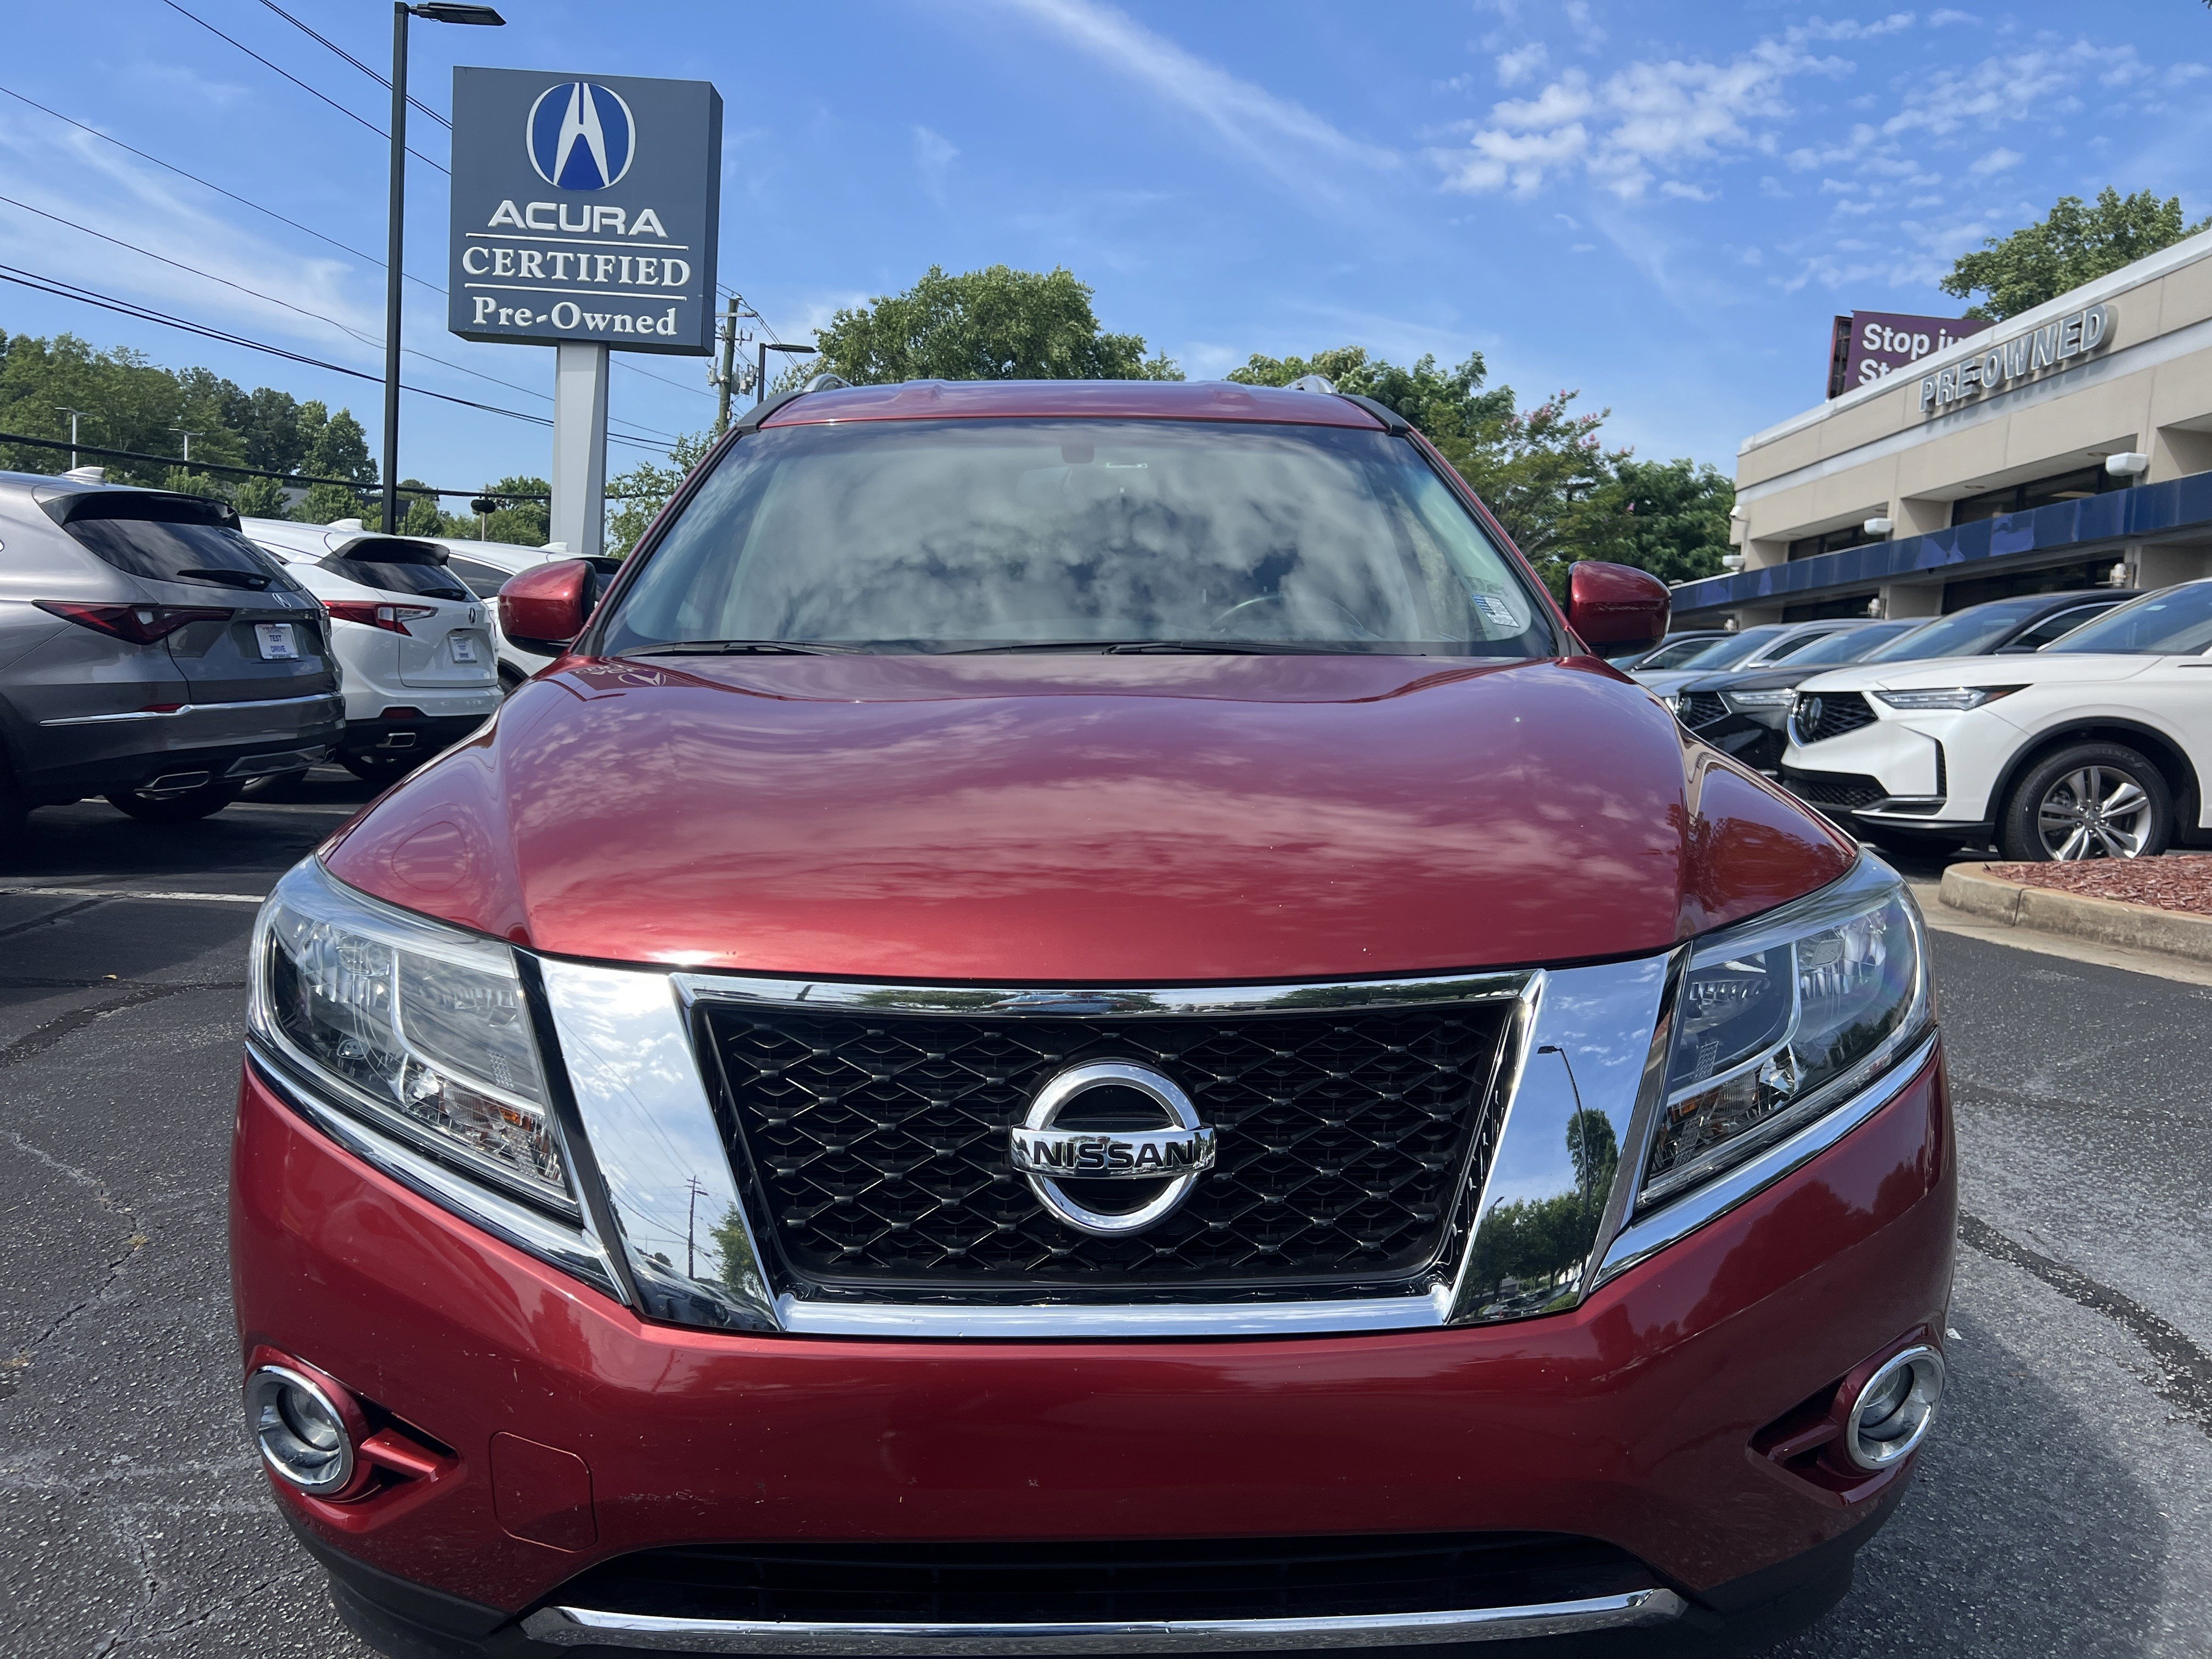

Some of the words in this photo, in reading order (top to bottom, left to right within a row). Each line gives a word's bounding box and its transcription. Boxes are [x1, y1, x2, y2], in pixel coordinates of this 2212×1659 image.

[487, 200, 669, 238] ACURA
[462, 246, 691, 287] CERTIFIED
[472, 296, 678, 337] Pre-Owned
[1862, 323, 1931, 361] Stop
[1919, 303, 2109, 413] PRE-OWNED
[1034, 1140, 1194, 1169] NISSAN
